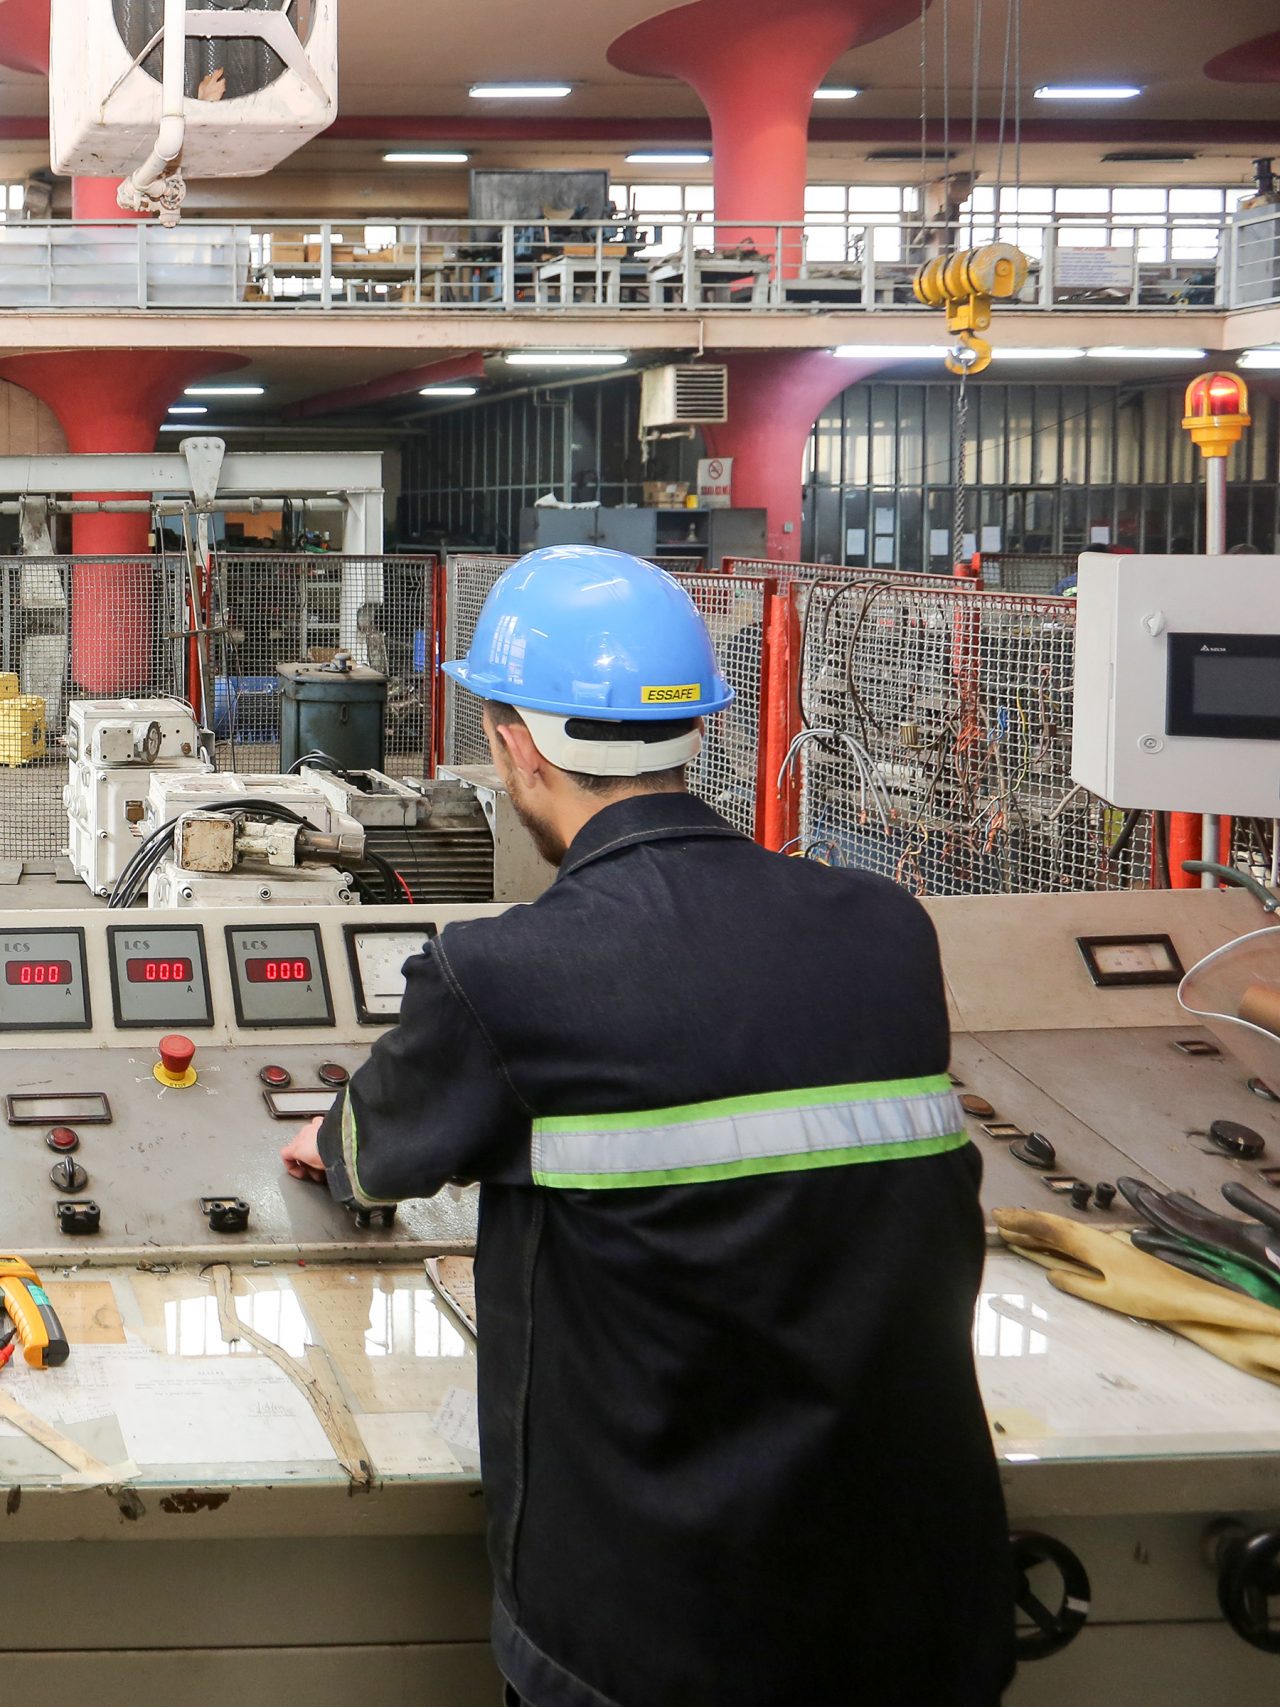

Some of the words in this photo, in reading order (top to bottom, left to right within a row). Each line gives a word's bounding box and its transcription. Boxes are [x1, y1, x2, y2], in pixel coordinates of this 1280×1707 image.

[647, 688, 694, 701] ESSAFE
[4, 942, 30, 952] LCS
[124, 940, 150, 950] LCS
[242, 940, 268, 950] LCS
[20, 965, 59, 984] 000
[146, 963, 183, 980] 000
[266, 962, 304, 980] 000
[65, 987, 72, 996] A
[186, 984, 194, 993] A
[306, 984, 313, 993] A
